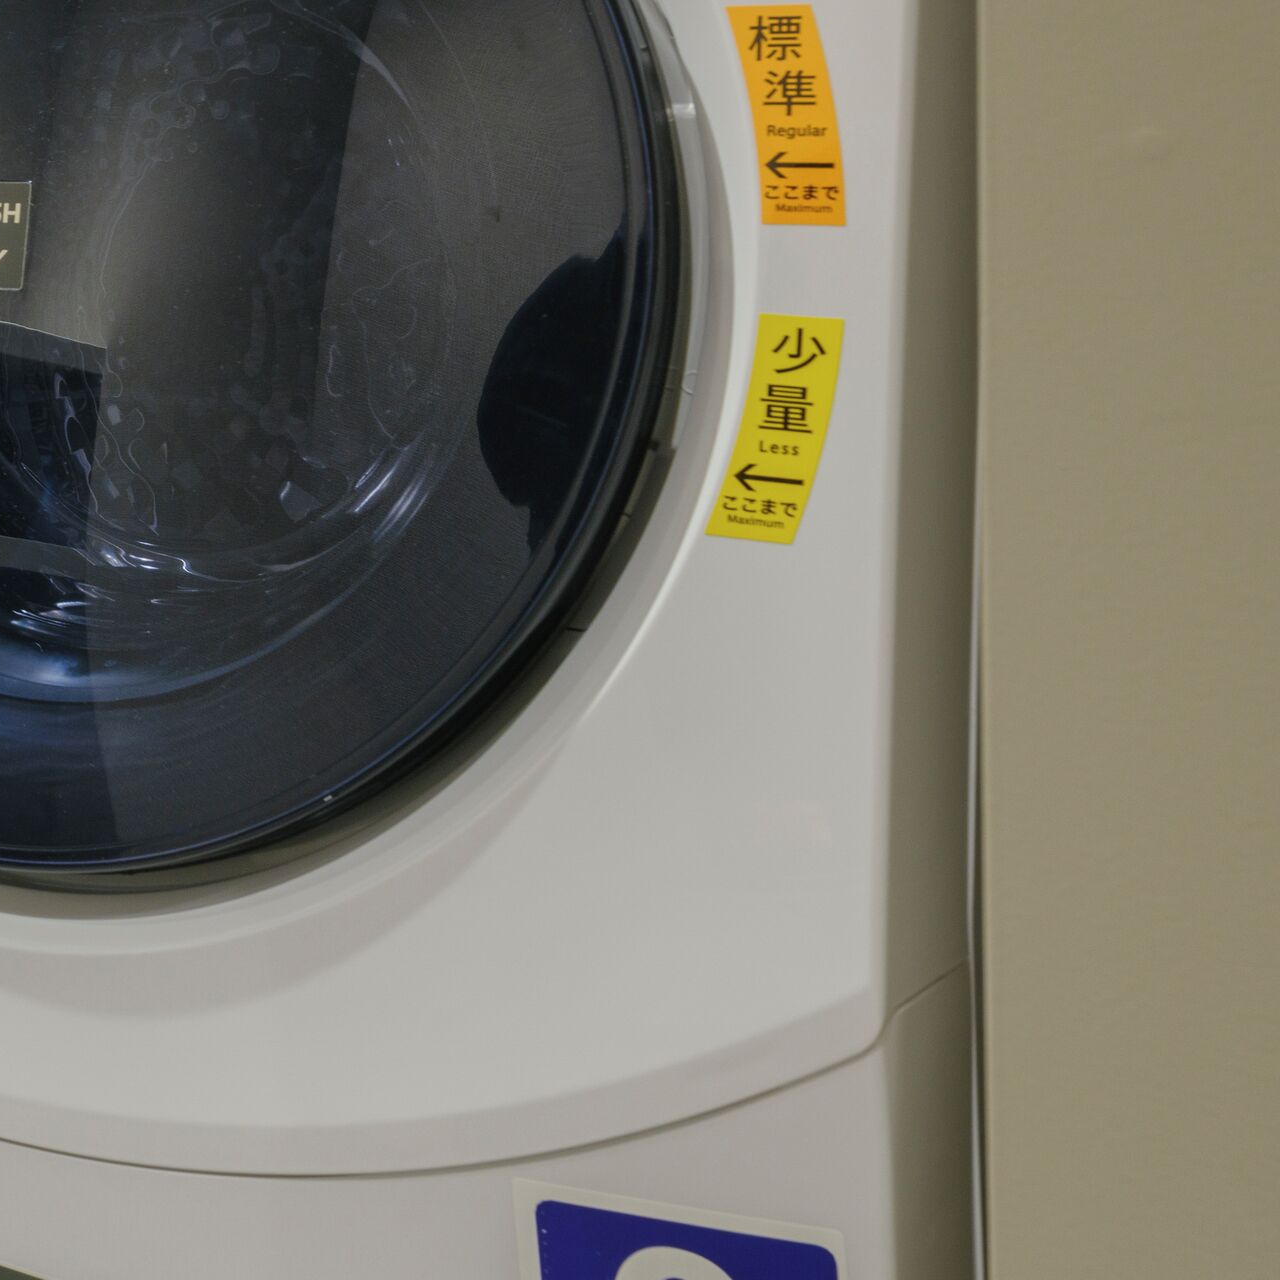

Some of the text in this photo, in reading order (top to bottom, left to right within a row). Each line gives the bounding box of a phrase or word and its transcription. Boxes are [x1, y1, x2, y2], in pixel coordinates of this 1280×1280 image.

[748, 14, 818, 117] 標準
[766, 123, 829, 140] Regular
[764, 184, 841, 202] ここまで
[774, 201, 834, 215] Maximum
[758, 326, 827, 435] 少量
[758, 439, 800, 458] Less
[721, 494, 799, 518] ここまで
[726, 514, 786, 531] Maximum
